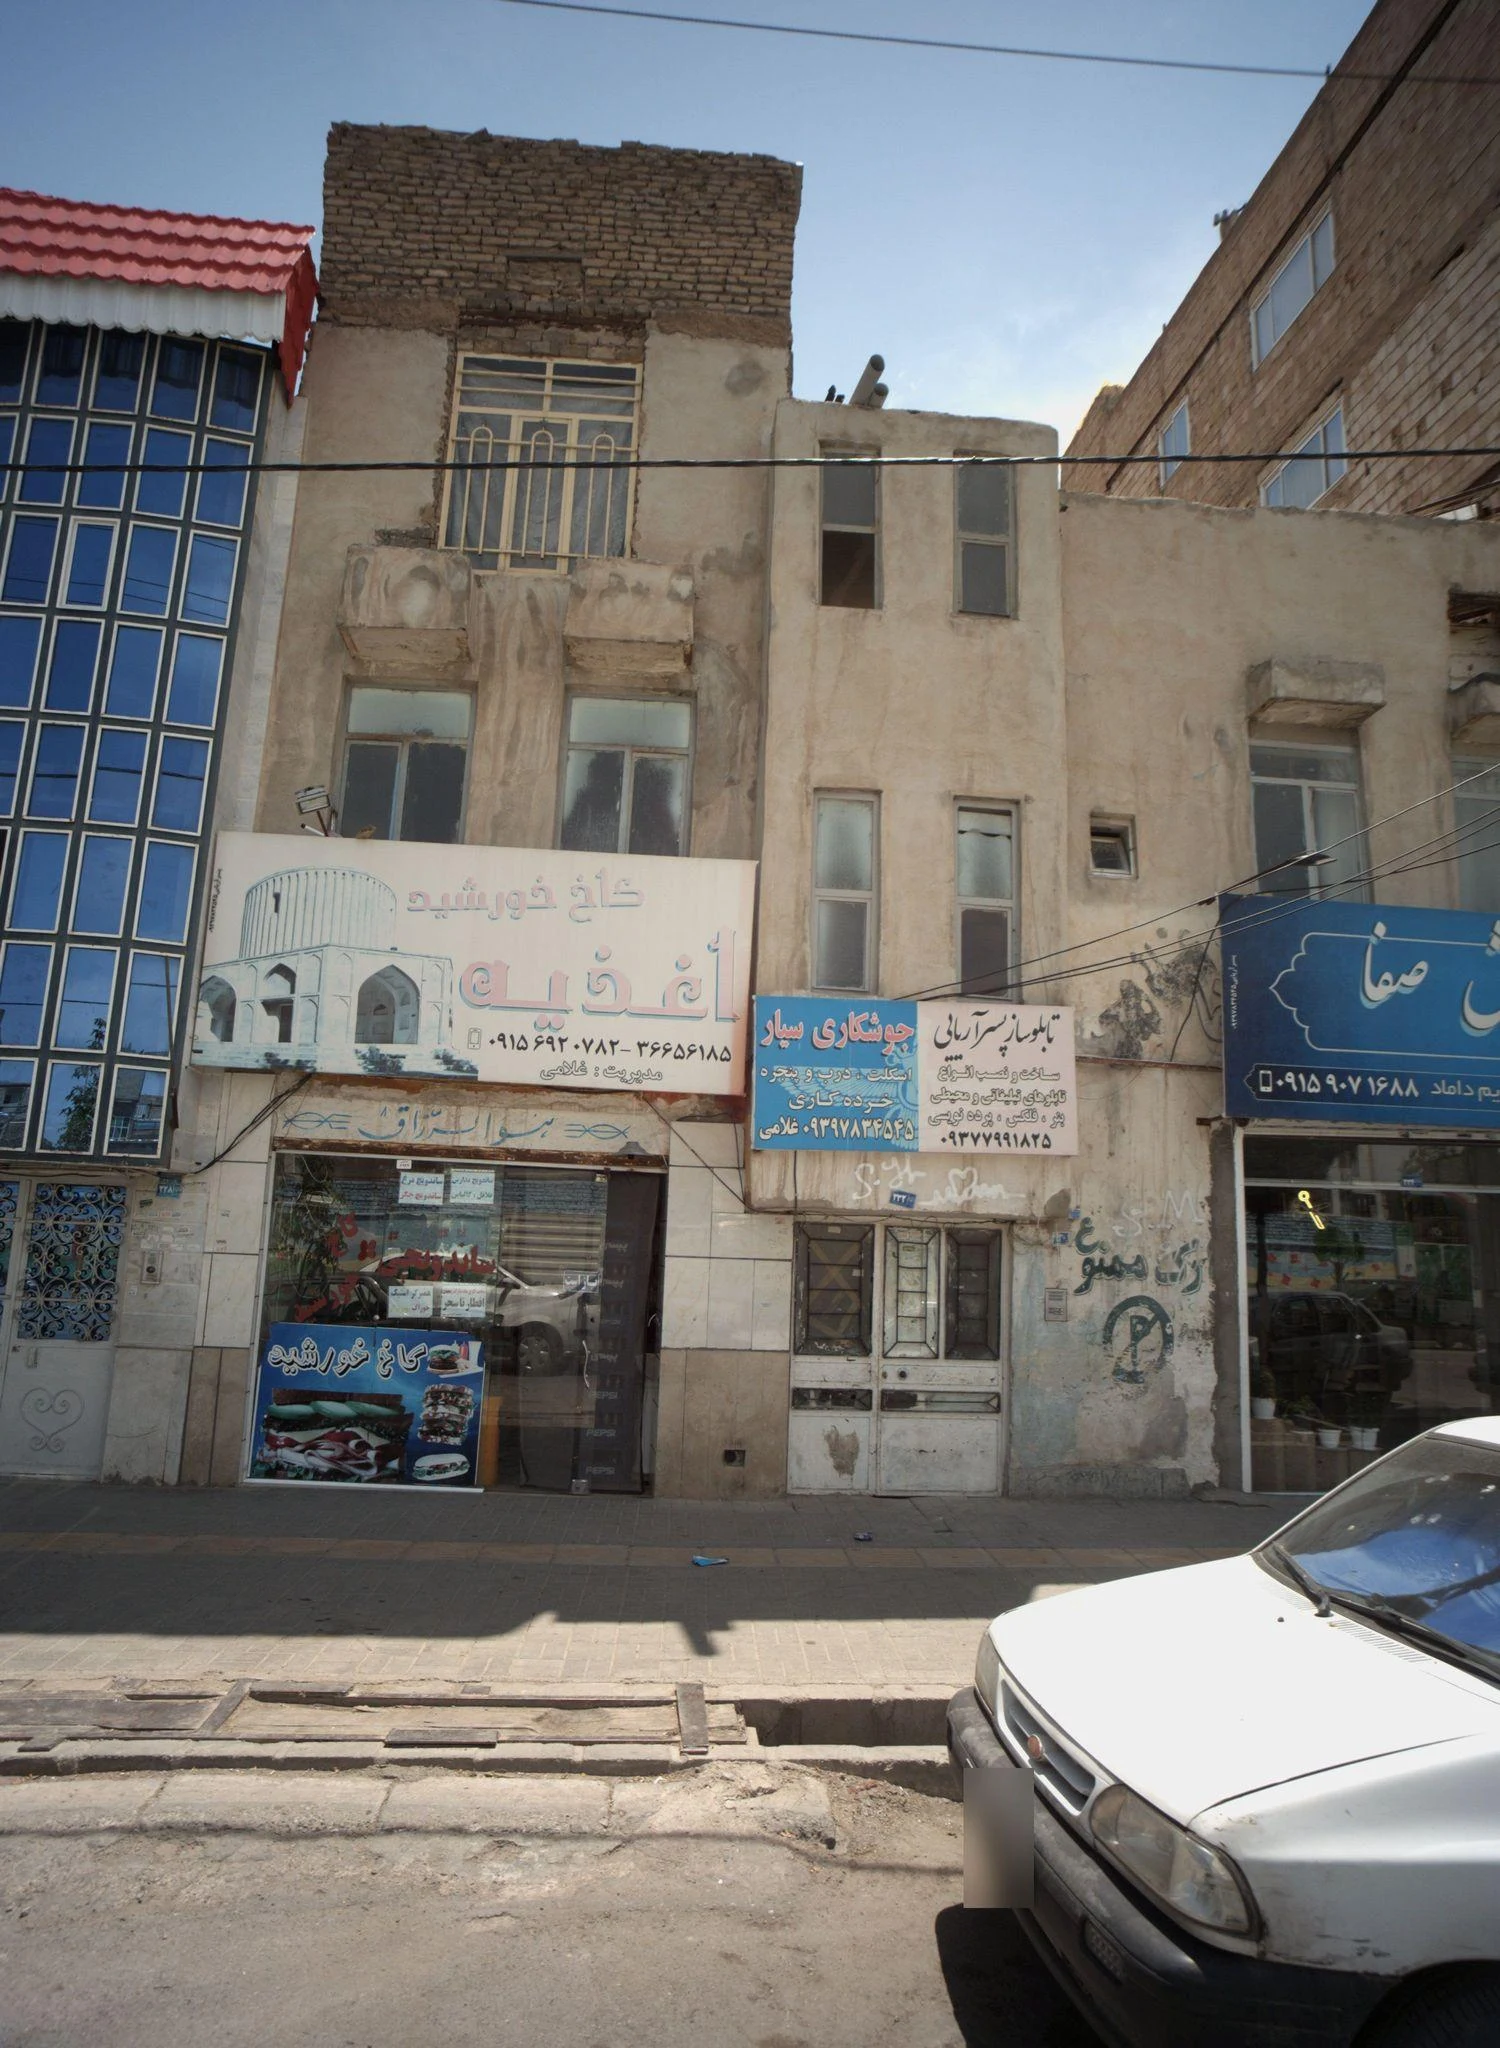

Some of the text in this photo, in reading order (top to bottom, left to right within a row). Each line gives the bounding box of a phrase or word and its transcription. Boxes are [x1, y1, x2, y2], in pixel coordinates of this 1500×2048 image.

[407, 868, 645, 923] کاخ خورشید
[760, 1008, 914, 1056] جوشکاری سیار
[488, 1032, 529, 1051] ۰۹۱۵
[533, 1034, 568, 1052] ۶۹۲
[636, 1040, 732, 1062] ۳۶۶۵۶۱۸۵
[540, 1060, 588, 1081] غلامی
[603, 1063, 663, 1084] مدیریت
[760, 1066, 799, 1083] پنجره
[804, 1068, 814, 1082] و
[817, 1067, 851, 1084] درب
[867, 1067, 913, 1082] اسکلت
[937, 1064, 974, 1082] انواع
[1011, 1072, 1018, 1084] و
[1019, 1067, 1060, 1081] ساخت
[1276, 1071, 1321, 1092] ۰۹۱۵
[1325, 1074, 1362, 1094] ۹۰۷
[1367, 1077, 1419, 1097] ۱۶۸۸
[788, 1090, 894, 1113] خرده کاری
[930, 1087, 970, 1104] محیطی
[972, 1093, 979, 1105] و
[1006, 1108, 1039, 1126] فلکس
[759, 1116, 915, 1140] ۰۹۳۹۷۸۳۴۵۴۵ غلامی
[941, 1130, 1052, 1149] ۰۹۳۷۷۹۹۱۸۲۵
[268, 1337, 428, 1379] کاخ خورشید
